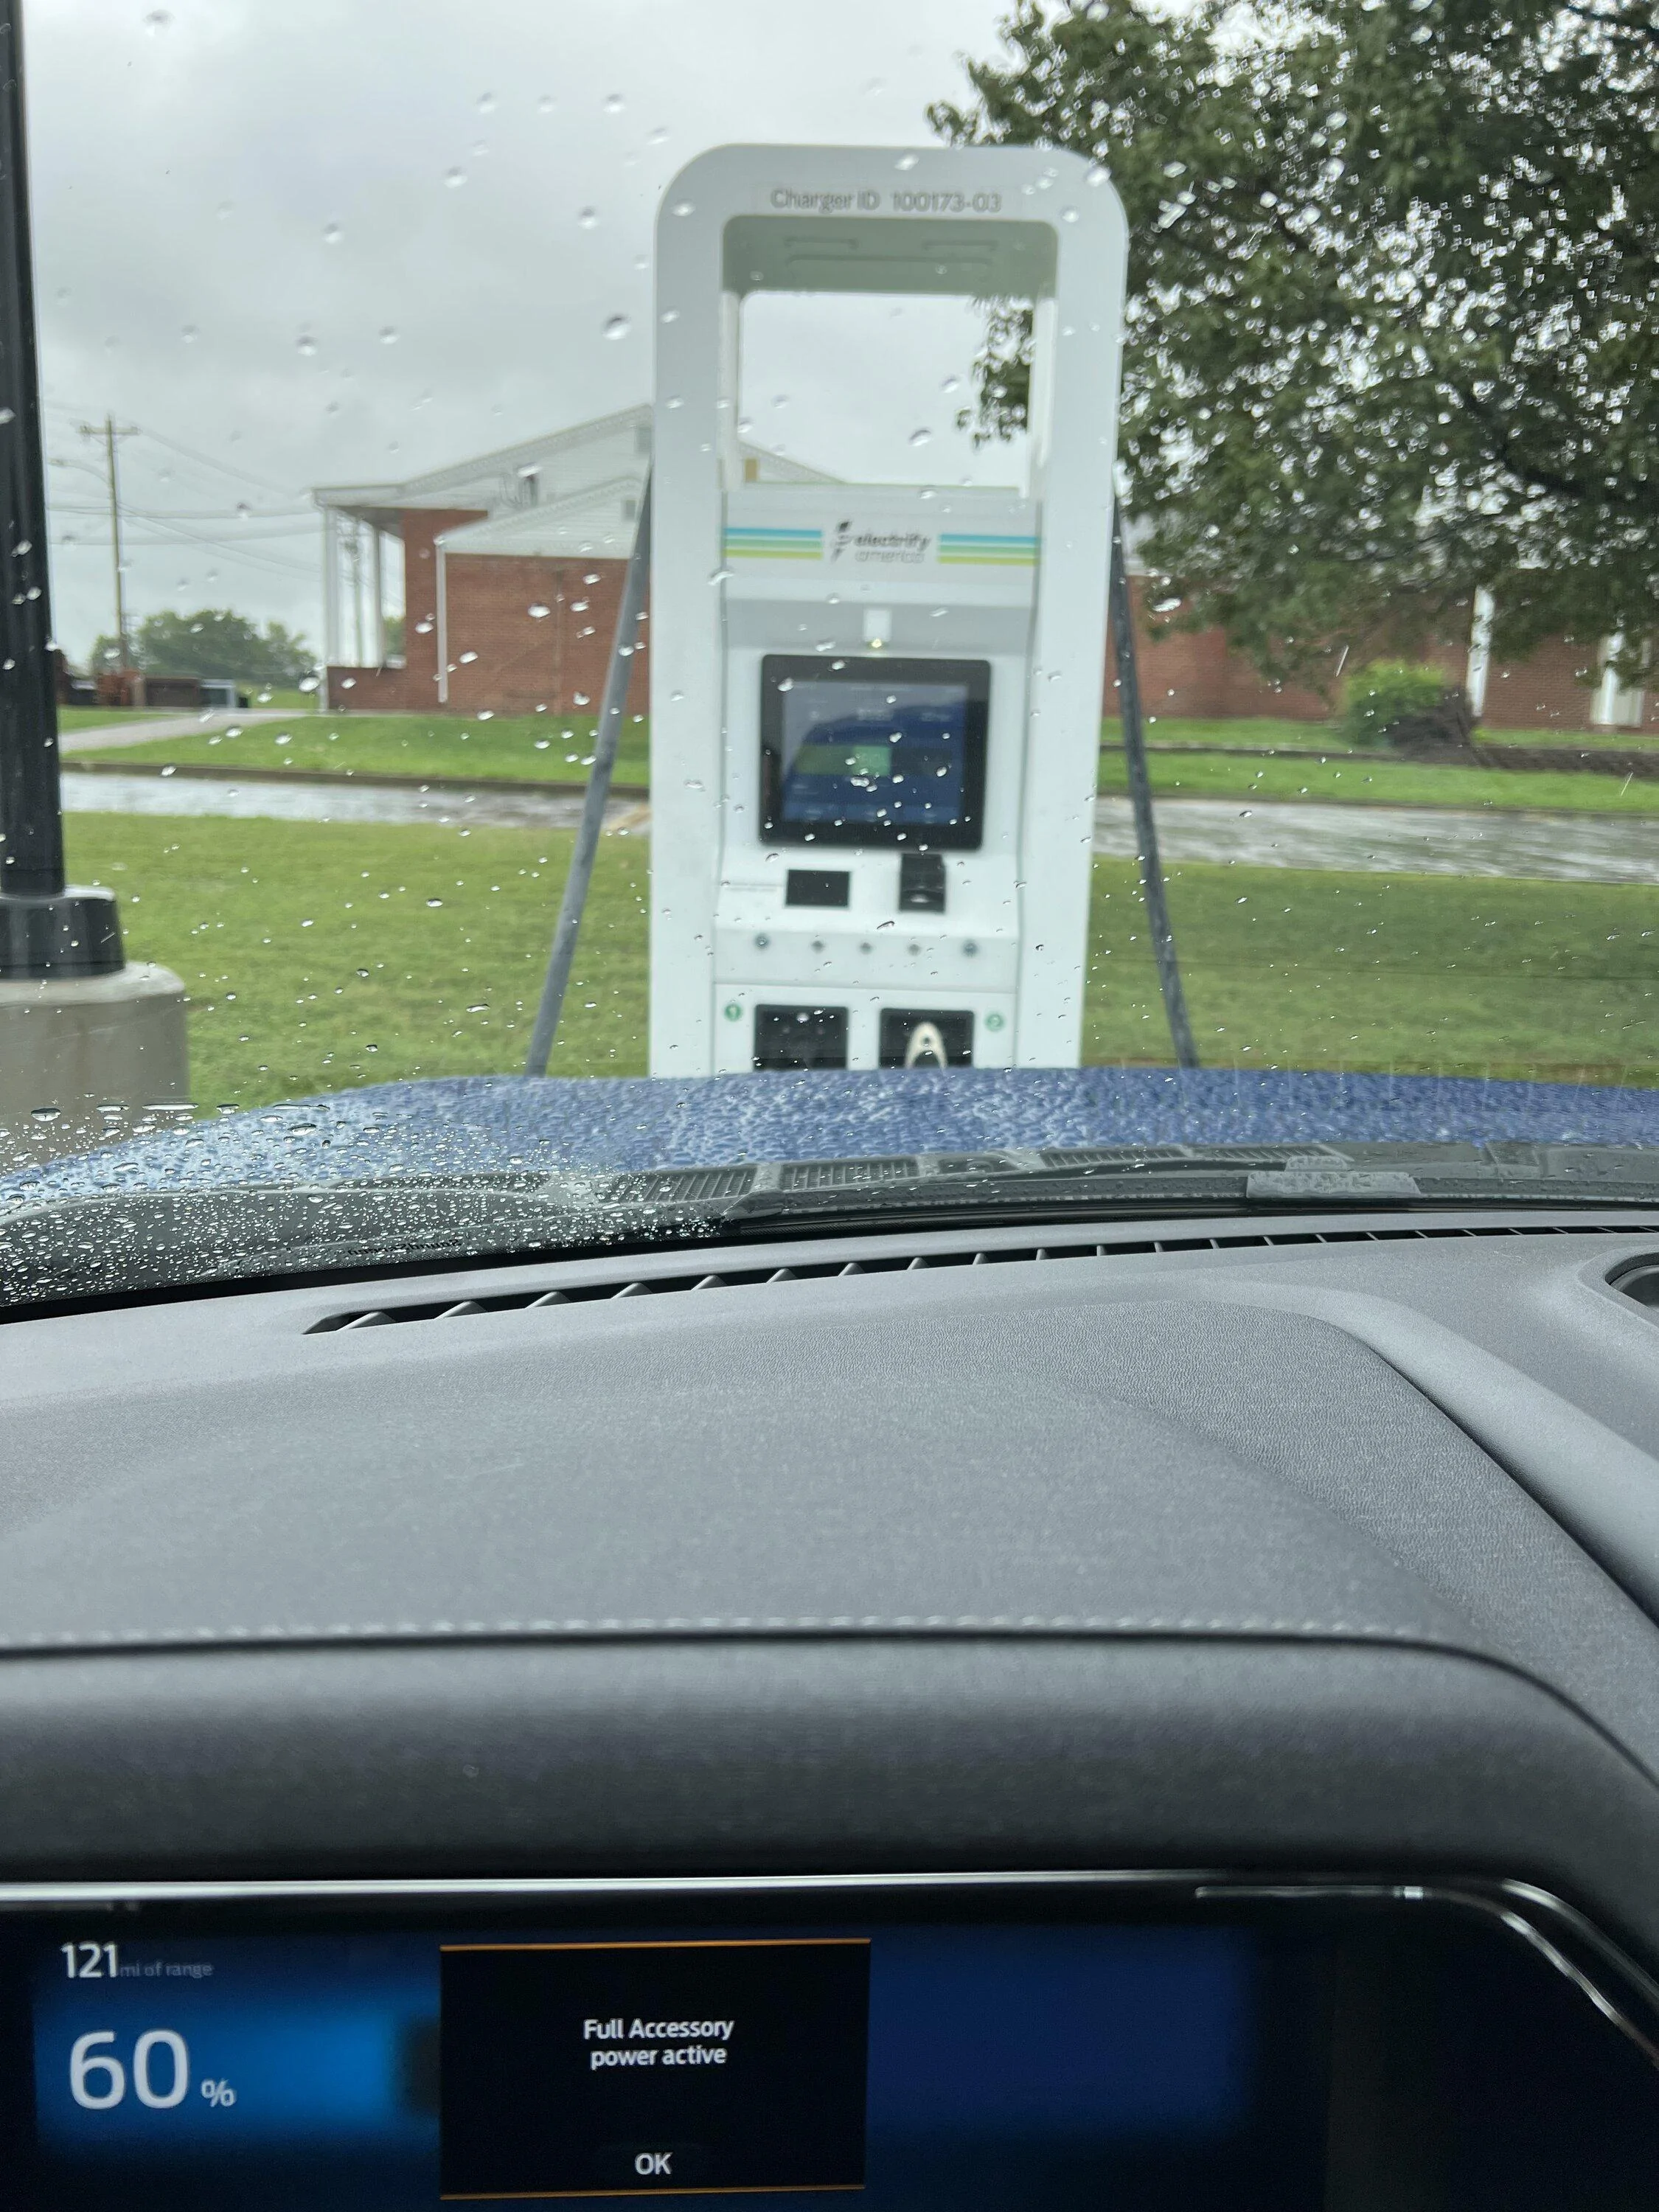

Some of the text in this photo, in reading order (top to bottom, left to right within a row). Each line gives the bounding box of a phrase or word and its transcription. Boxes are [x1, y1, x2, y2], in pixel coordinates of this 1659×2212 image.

[770, 189, 1003, 214] Charger ID 100173-03
[60, 1941, 214, 1980] 121 mi of range
[583, 2018, 735, 2041] Full Accessory
[69, 2028, 237, 2110] 60 %
[590, 2044, 727, 2070] power active
[634, 2152, 673, 2176] OK
